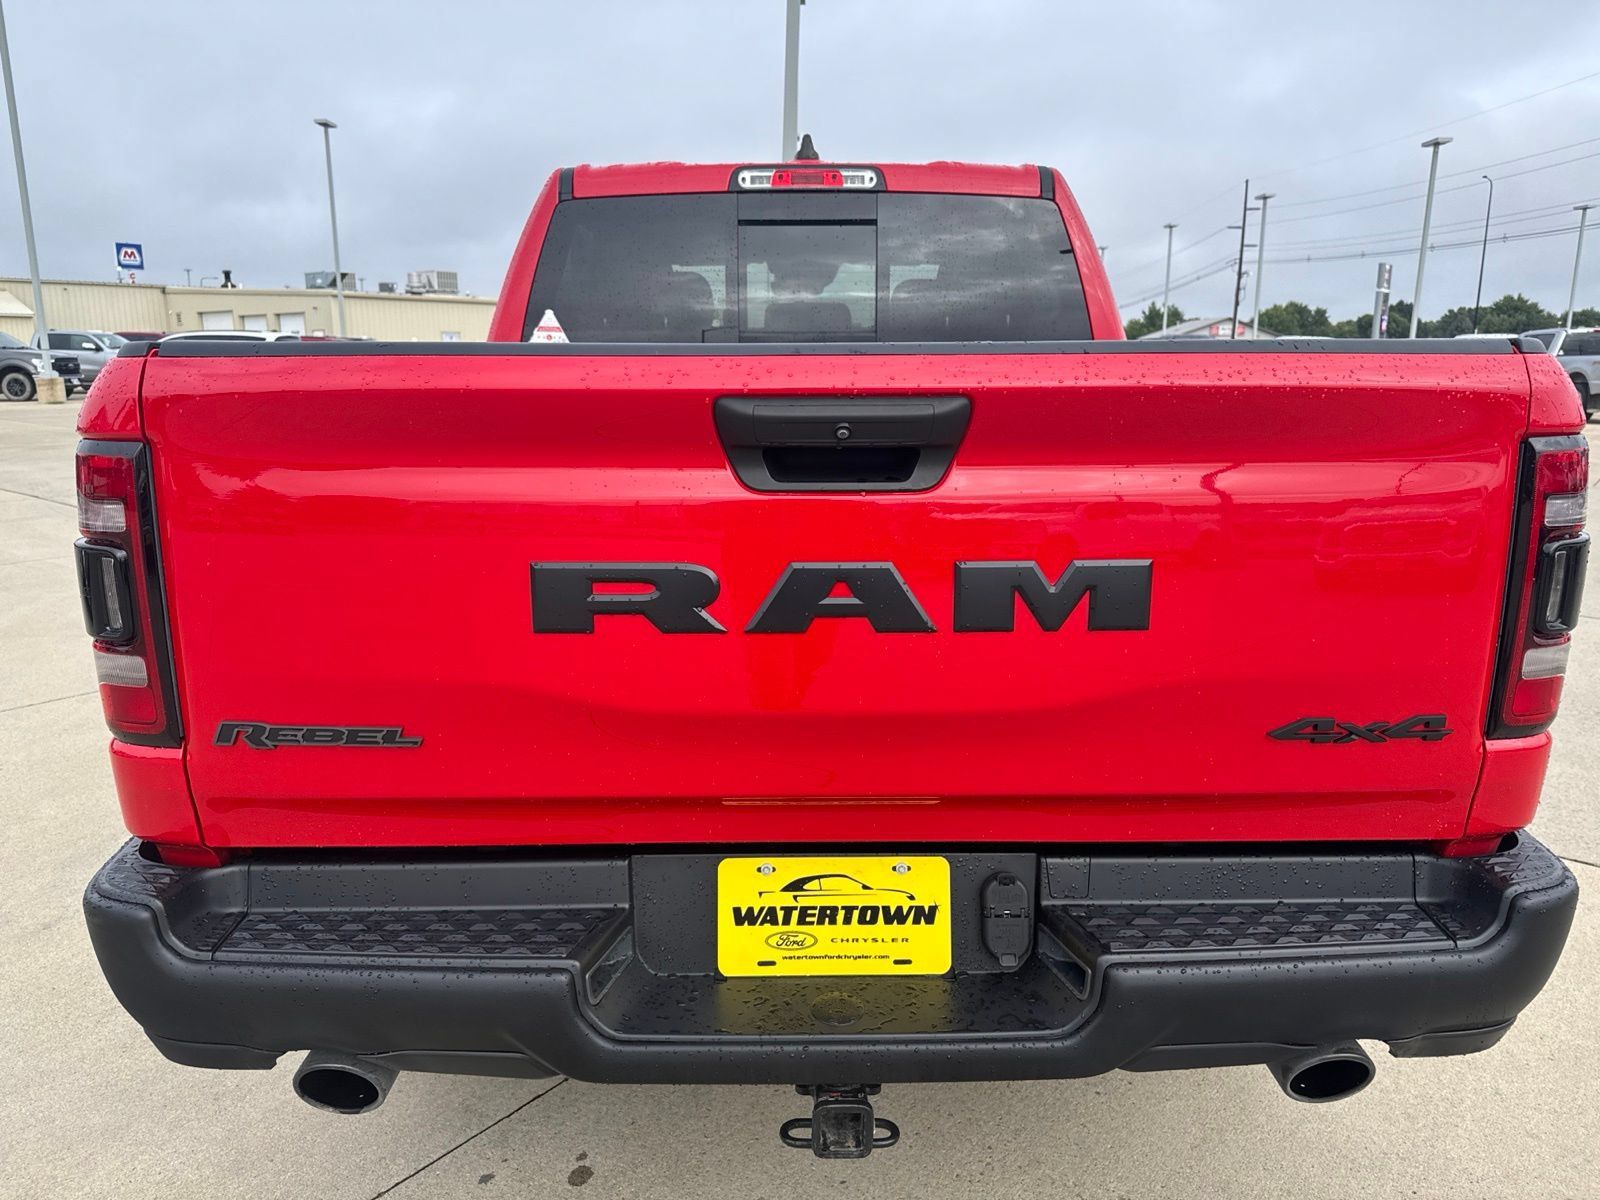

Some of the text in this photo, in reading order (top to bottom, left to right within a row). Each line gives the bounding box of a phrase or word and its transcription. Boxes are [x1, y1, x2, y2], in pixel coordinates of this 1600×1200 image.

[530, 559, 1153, 634] RAM
[213, 720, 424, 750] REBEL
[732, 904, 938, 926] WATERTOWN
[775, 933, 807, 947] Ford
